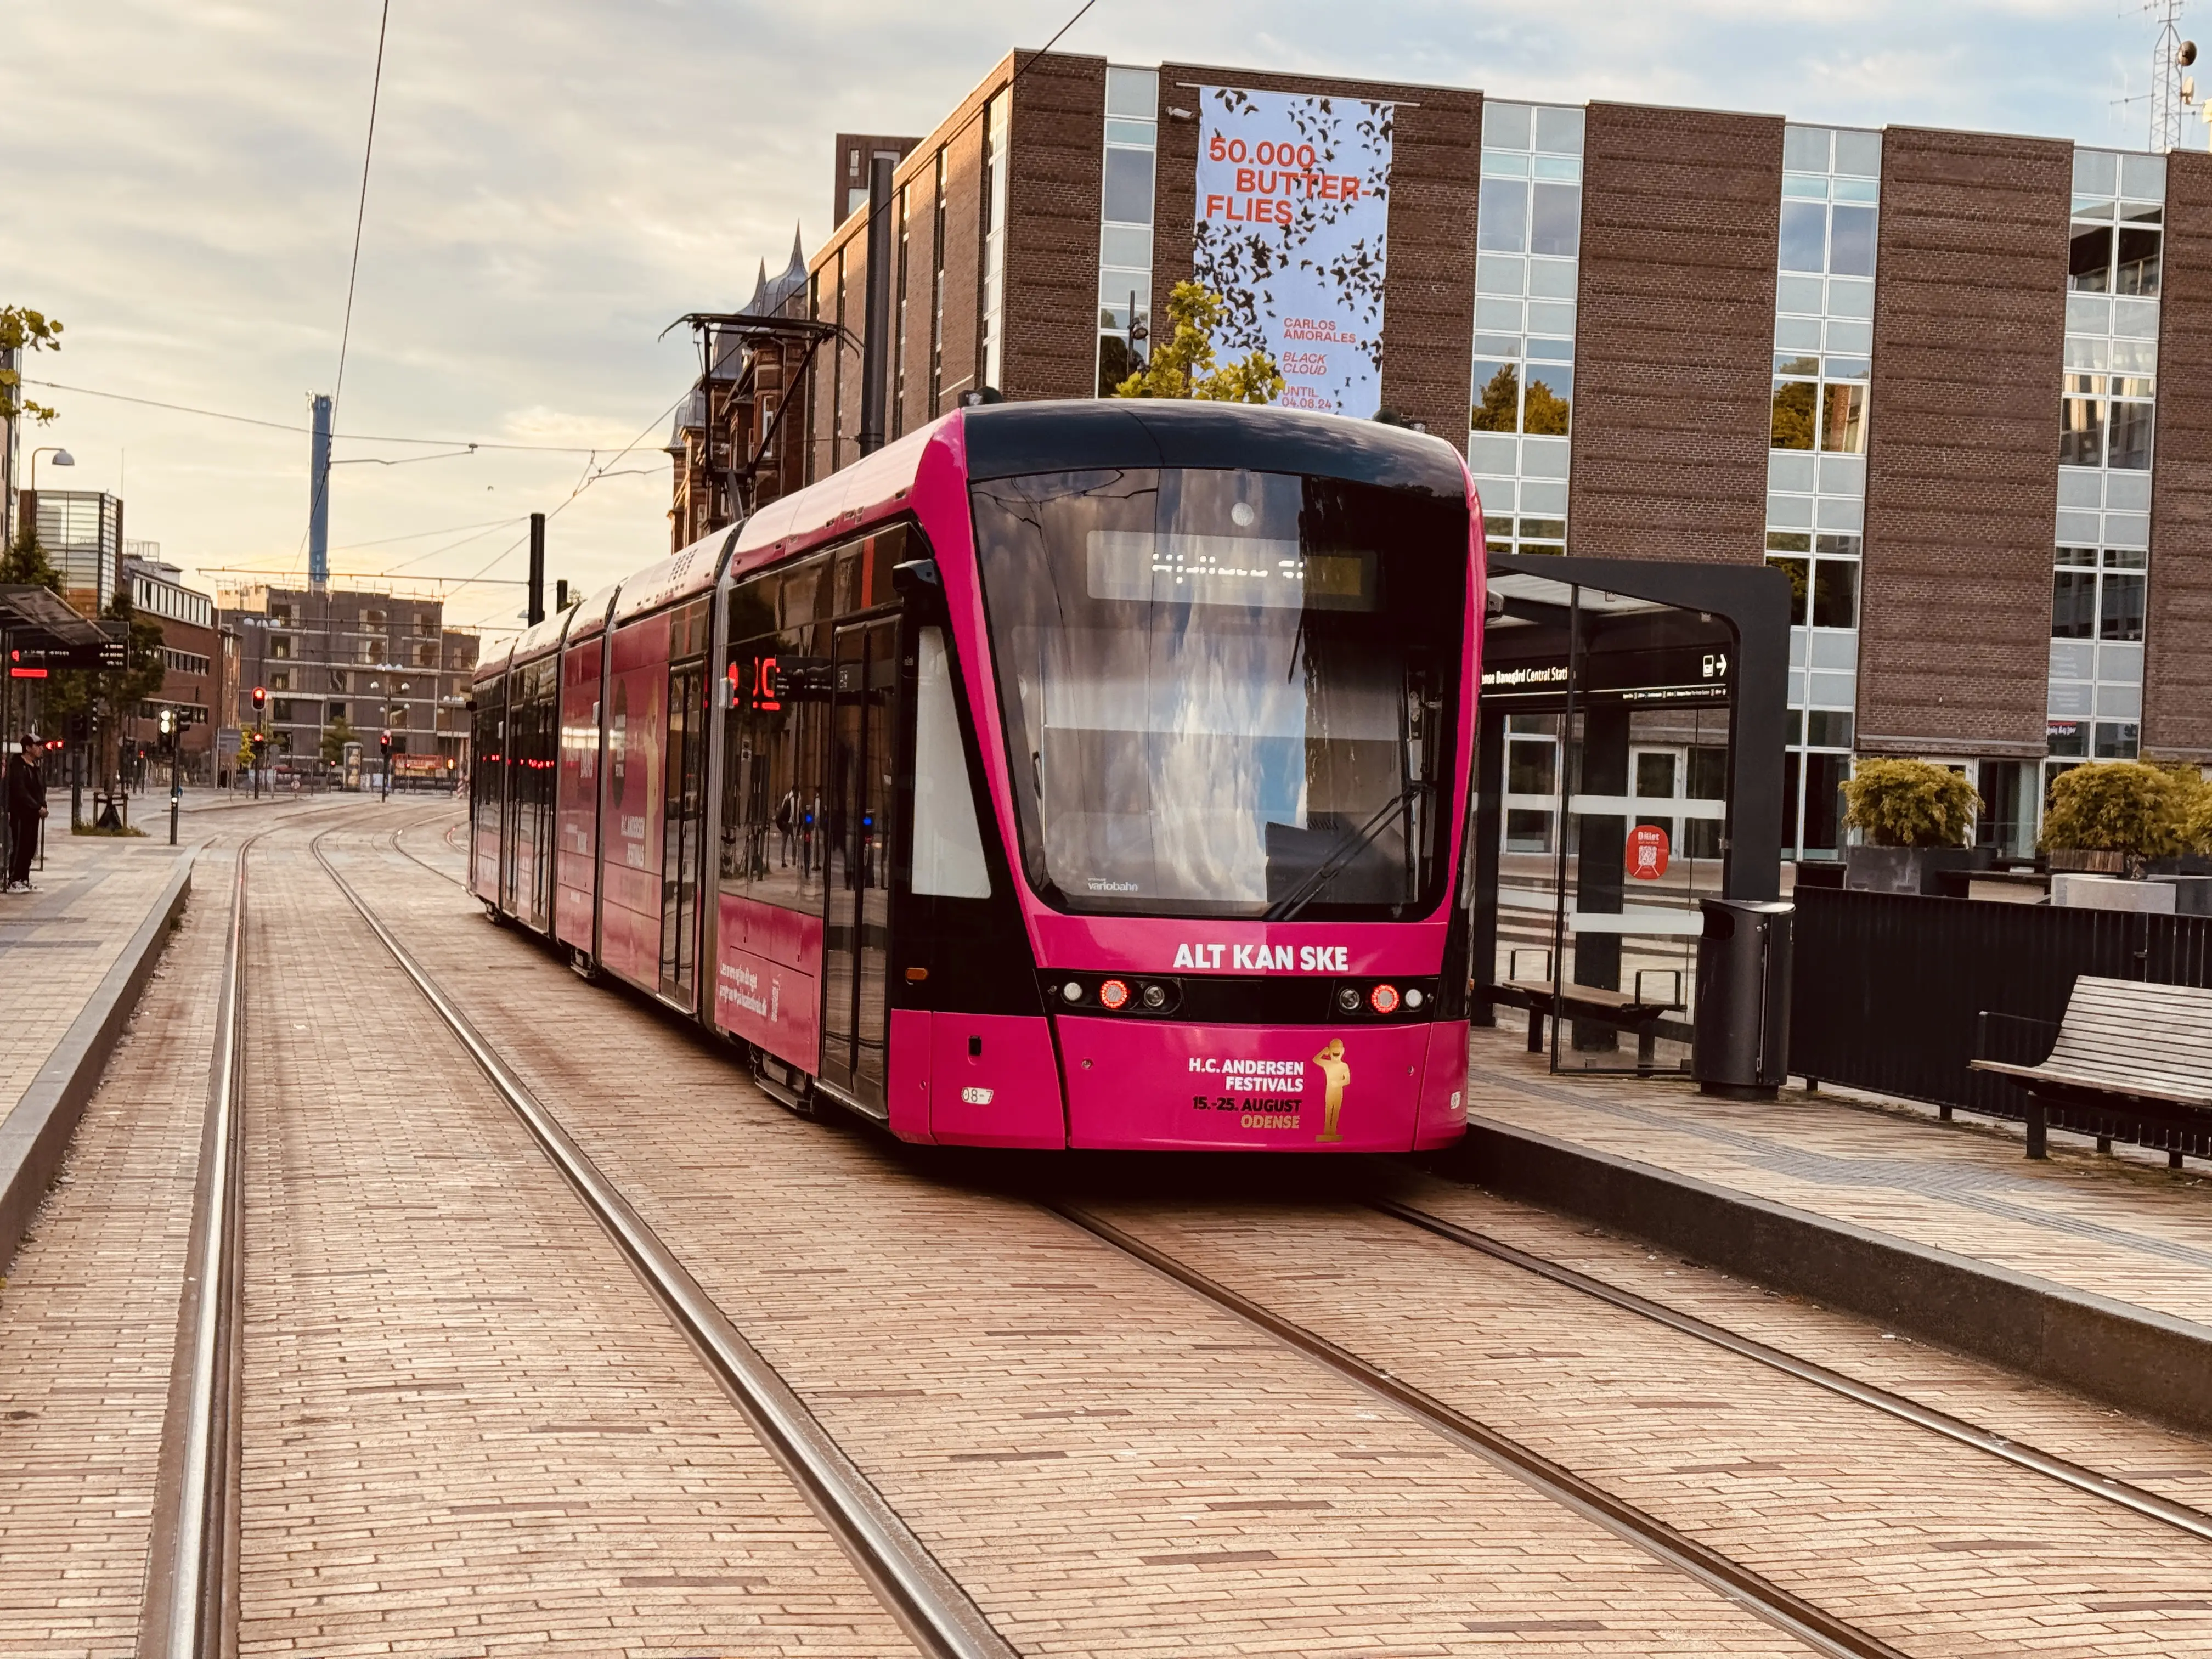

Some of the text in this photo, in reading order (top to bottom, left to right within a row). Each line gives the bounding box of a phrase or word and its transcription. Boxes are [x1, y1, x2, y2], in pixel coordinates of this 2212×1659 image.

[1209, 137, 1316, 168] 50.000
[1237, 168, 1371, 201] BUTTER-
[1207, 194, 1293, 224] FLIES
[1284, 318, 1336, 330] CARLOS
[1284, 329, 1356, 343] AMORALES
[1283, 351, 1327, 364] BLACK
[1283, 363, 1327, 375] CLOUD
[1282, 386, 1319, 397] UNTIL
[1282, 397, 1331, 409] 04.08.24
[1482, 666, 1576, 686] ense Banegård Central Stati
[1088, 881, 1138, 891] variobahn
[1173, 943, 1348, 971] ALT KAN SKE
[1222, 1059, 1304, 1075] ANDERSEN
[1226, 1076, 1304, 1092] FESTIVALS
[1240, 1098, 1302, 1113] AUGUST
[1241, 1114, 1300, 1129] ODENSE
